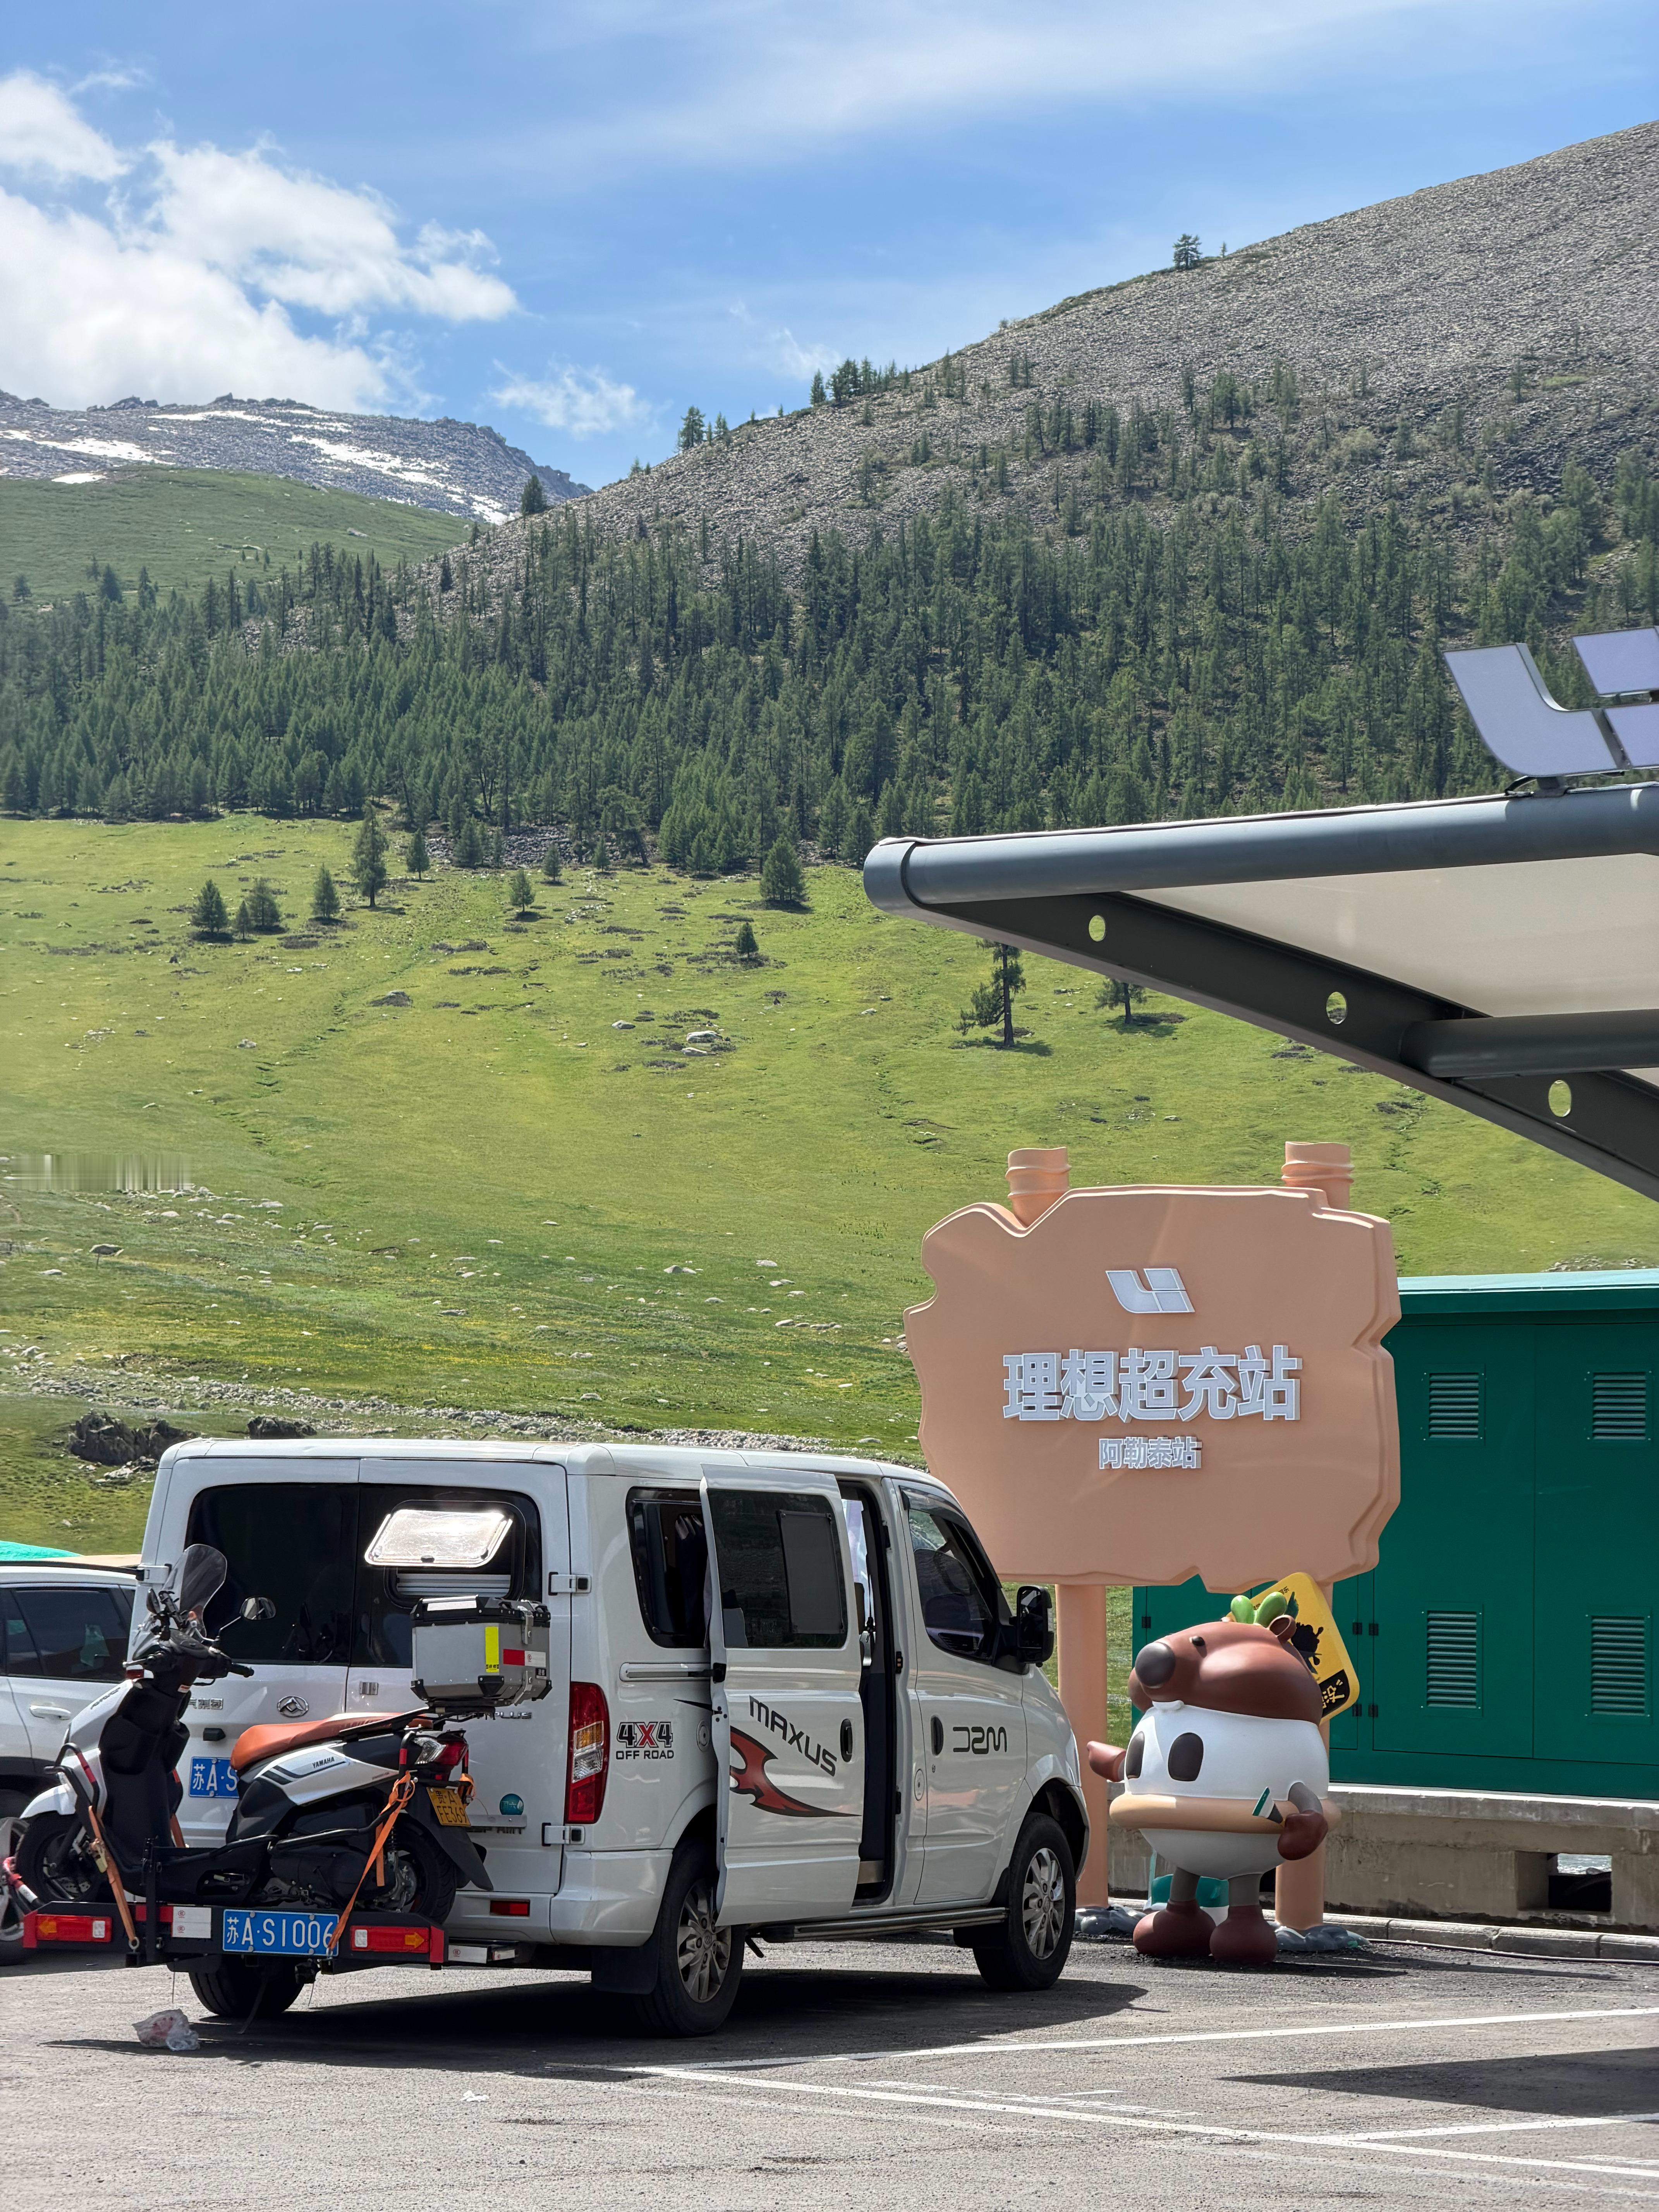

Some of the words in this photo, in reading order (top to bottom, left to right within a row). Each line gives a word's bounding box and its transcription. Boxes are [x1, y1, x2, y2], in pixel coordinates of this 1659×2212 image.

[1003, 1345, 1302, 1422] 理想超充站
[1099, 1436, 1202, 1469] 阿勒泰站
[617, 1721, 673, 1748] 4X4
[749, 1695, 837, 1777] MAXUS
[312, 1756, 335, 1769] YAMAHA
[616, 1750, 639, 1759] OFF
[644, 1750, 674, 1759] ROAD
[436, 1805, 467, 1824] FE369
